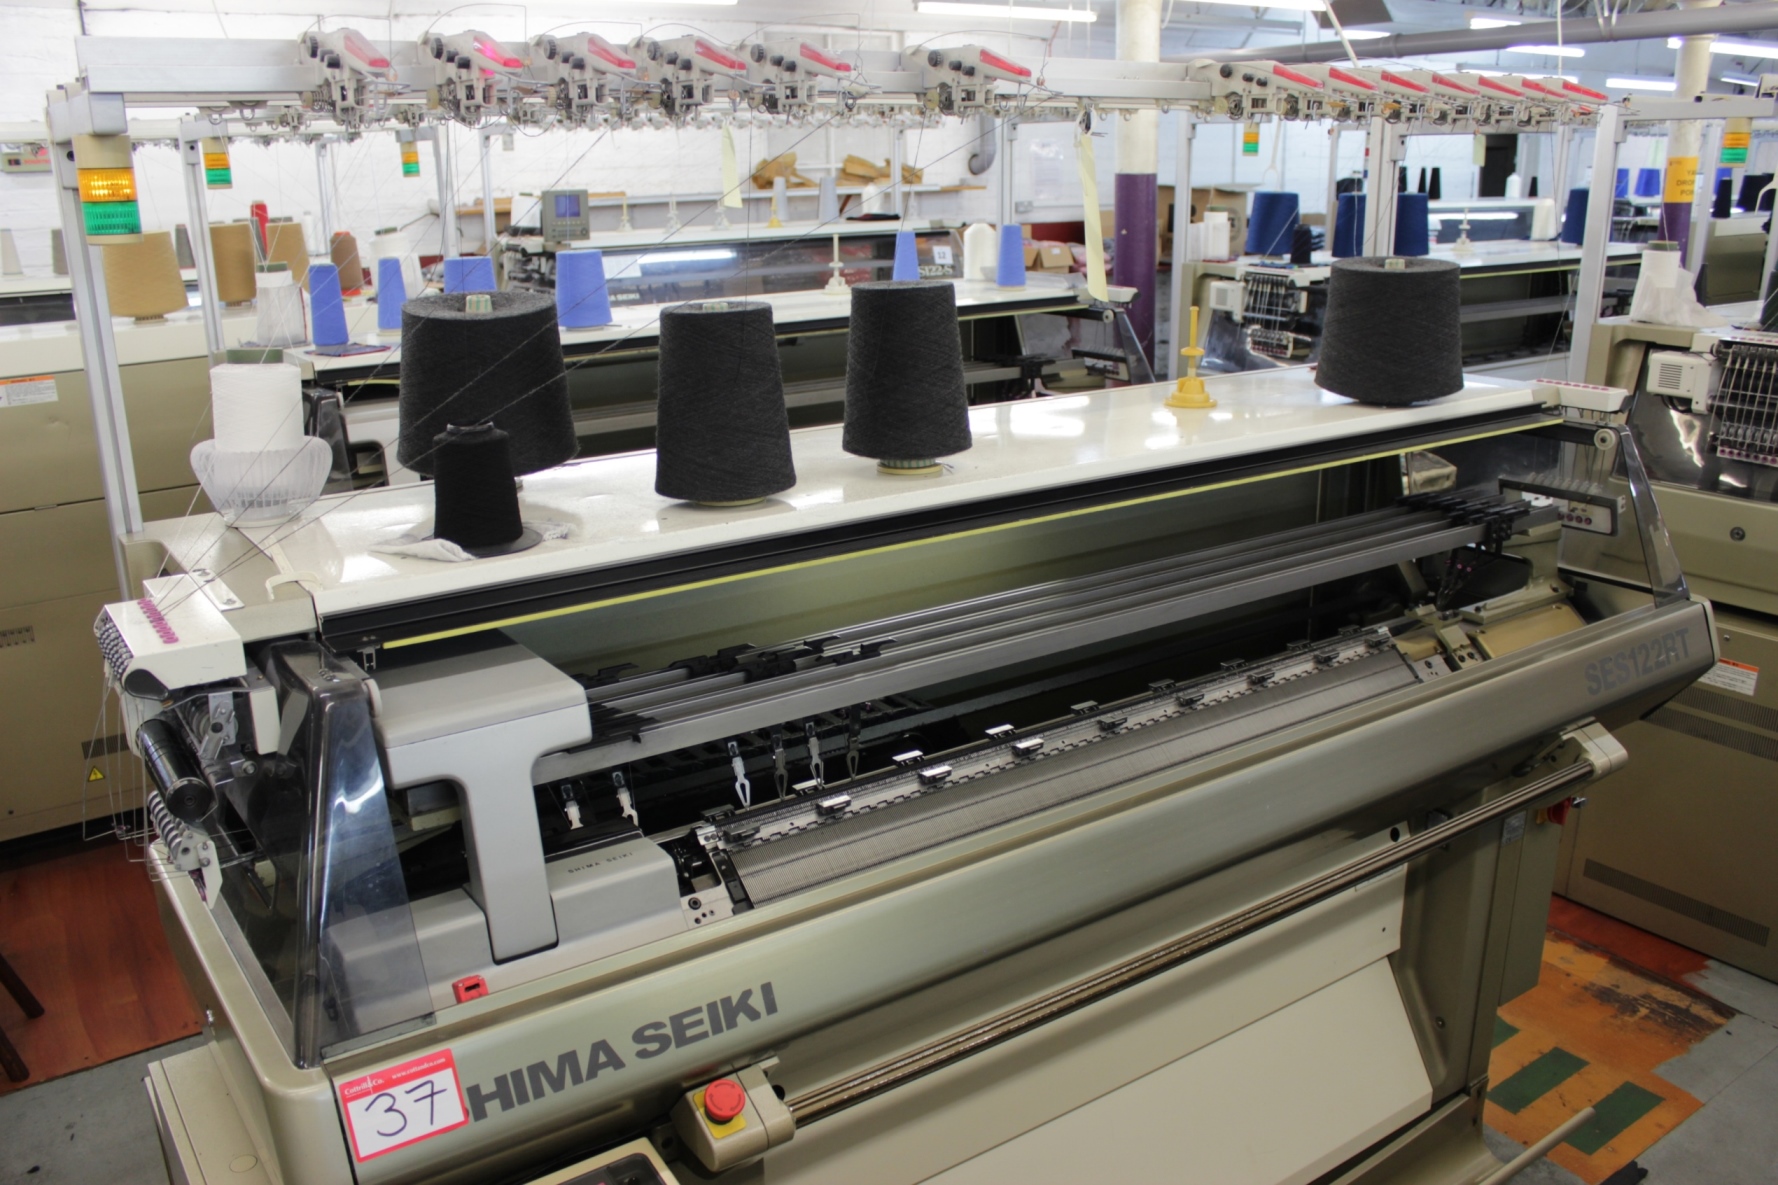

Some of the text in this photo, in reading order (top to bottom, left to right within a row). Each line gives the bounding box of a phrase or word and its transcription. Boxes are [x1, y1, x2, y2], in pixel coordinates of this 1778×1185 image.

[937, 251, 947, 260] 12
[1585, 626, 1689, 696] SES122RT
[567, 851, 633, 874] SHIMA SEIKI
[466, 981, 778, 1122] HIMA SEIKI
[364, 1079, 448, 1137] 37
